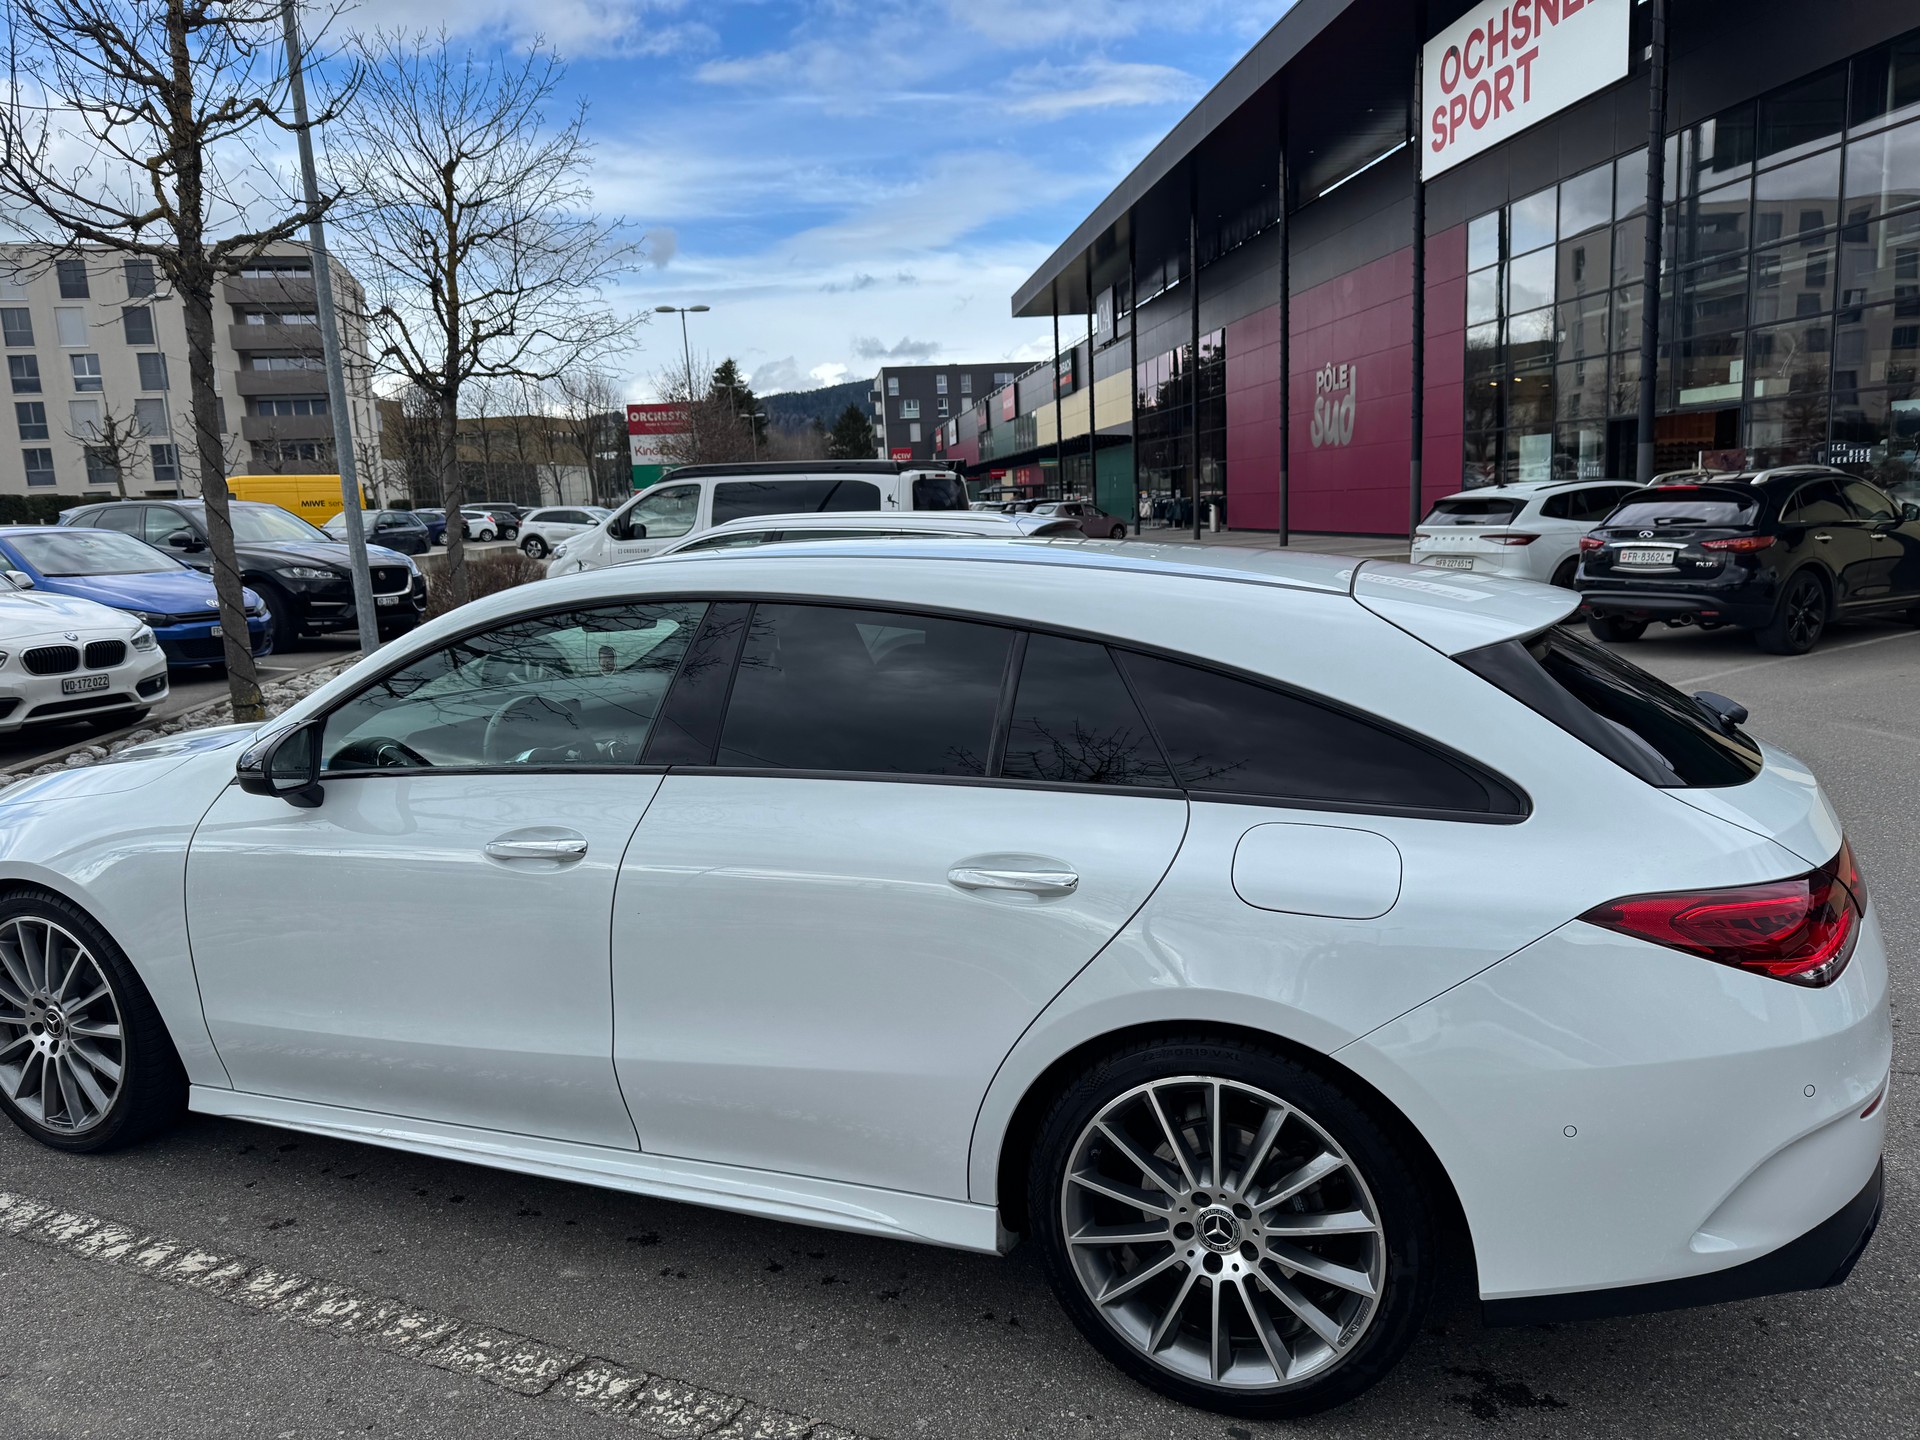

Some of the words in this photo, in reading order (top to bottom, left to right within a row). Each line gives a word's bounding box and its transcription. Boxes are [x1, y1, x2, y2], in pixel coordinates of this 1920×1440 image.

[1440, 0, 1594, 94] OCHSN
[1432, 46, 1539, 153] SPORT
[1316, 361, 1349, 394] PÔLE
[1831, 456, 1870, 464] SERVICE
